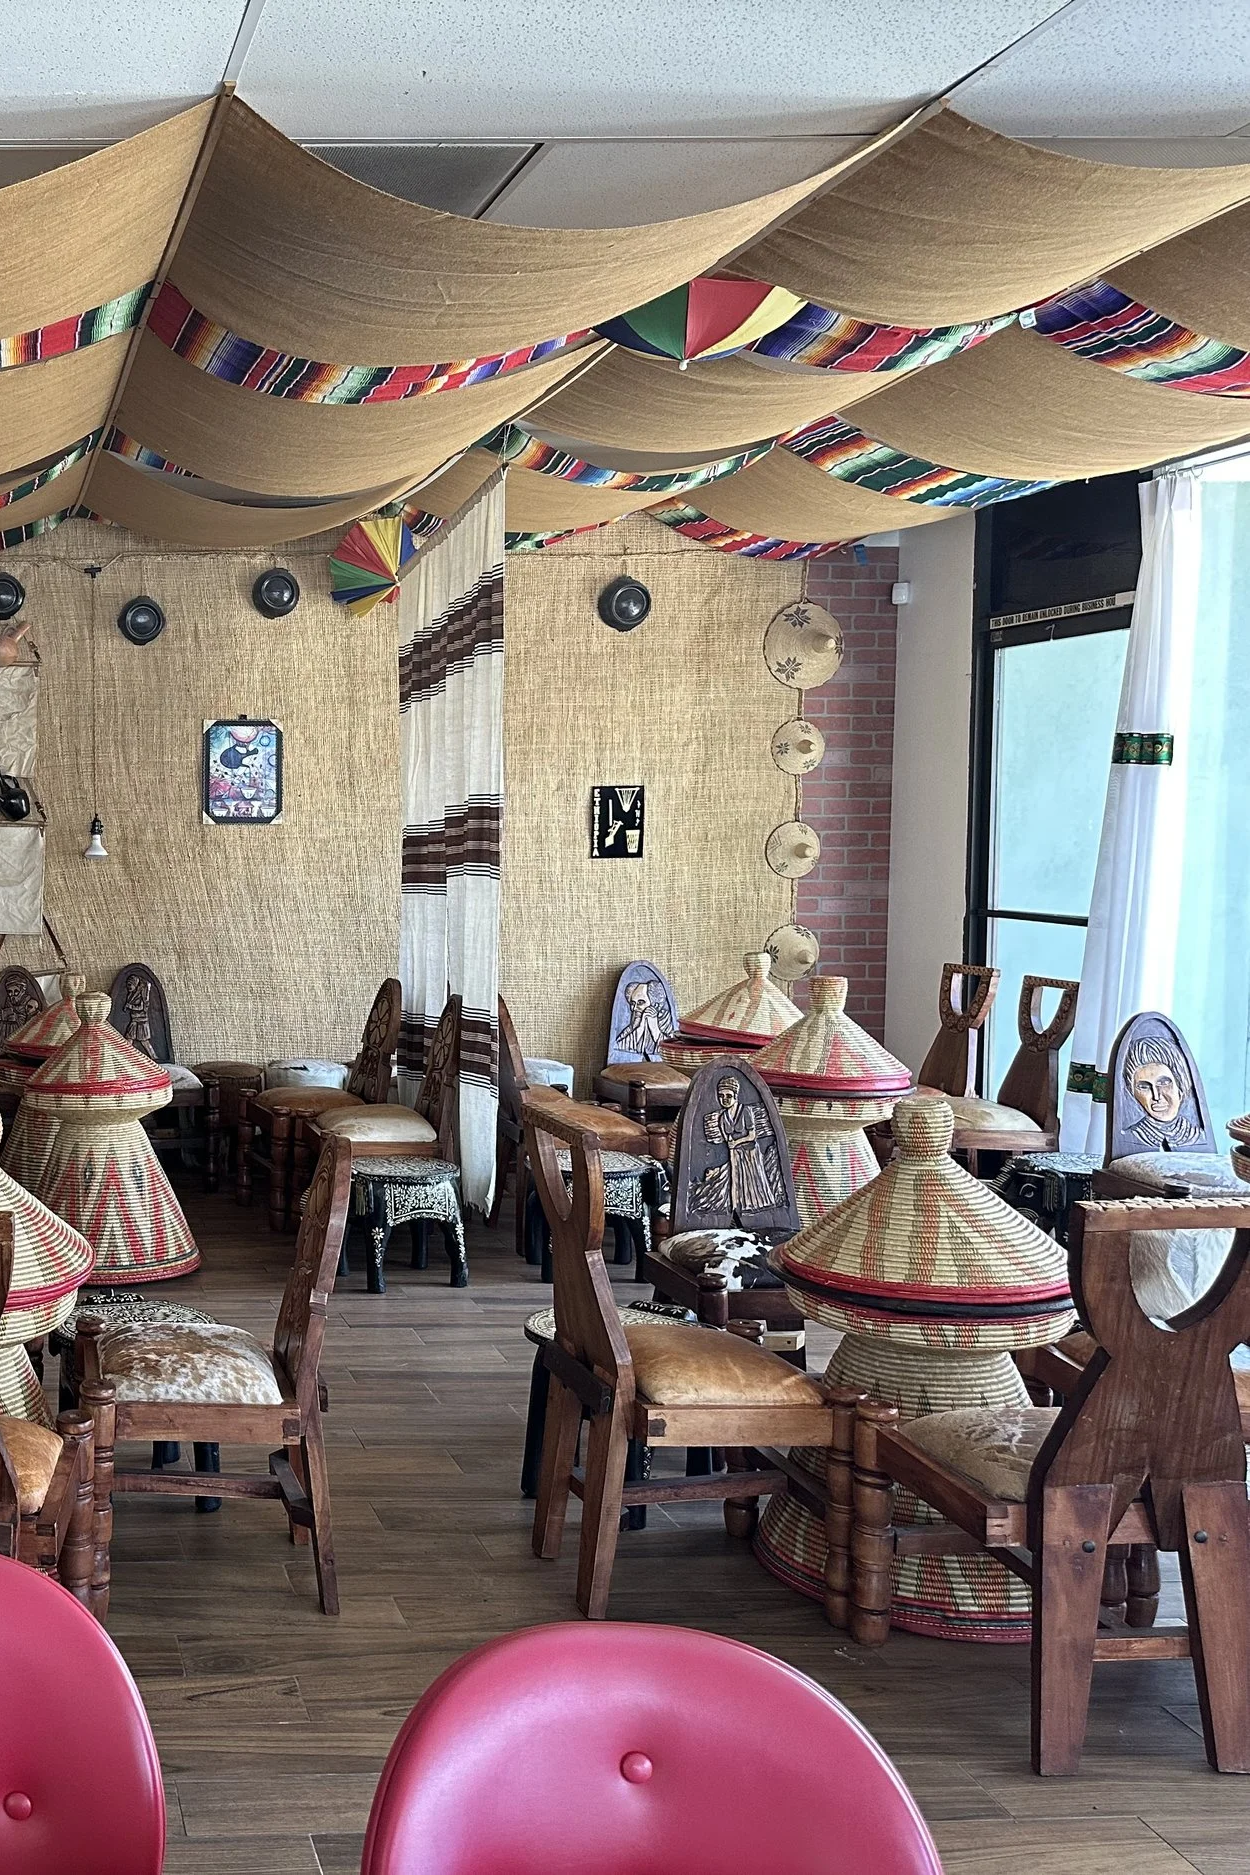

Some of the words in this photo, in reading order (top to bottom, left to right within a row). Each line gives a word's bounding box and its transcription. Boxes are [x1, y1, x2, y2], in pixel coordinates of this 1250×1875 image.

[992, 619, 1001, 628] THIS
[1002, 616, 1014, 625] DOOR
[1015, 614, 1021, 623] TO
[1022, 611, 1038, 622] REMAIN
[1040, 607, 1062, 619] UNLOCKED
[1063, 604, 1080, 615] DURING
[1082, 599, 1104, 611] BUSINESS
[1106, 596, 1116, 607] HOU
[592, 788, 601, 857] ETHIOPIA
